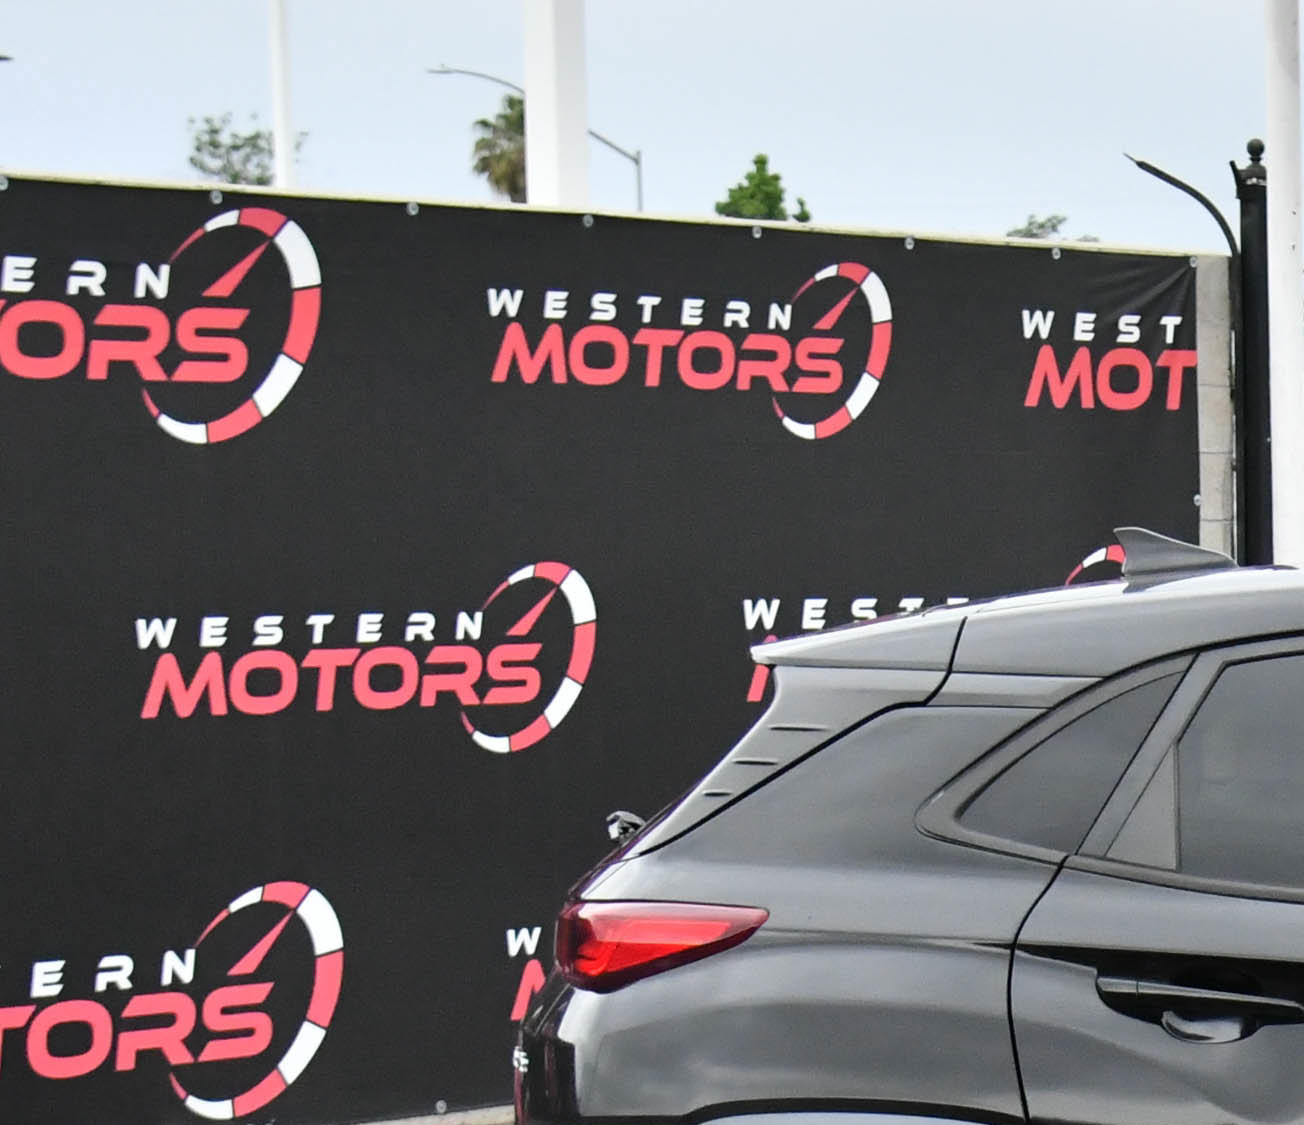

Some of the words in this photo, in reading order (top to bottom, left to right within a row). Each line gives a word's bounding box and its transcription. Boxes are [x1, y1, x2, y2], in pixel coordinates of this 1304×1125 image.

[0, 255, 171, 299] ERN
[487, 288, 793, 331] WESTERN
[1021, 309, 1184, 344] WEST
[491, 321, 844, 394] MOTORS
[1023, 344, 1199, 411] MOT
[135, 611, 484, 650] WESTERN
[140, 642, 542, 719] MOTORS
[30, 948, 196, 998] ERN
